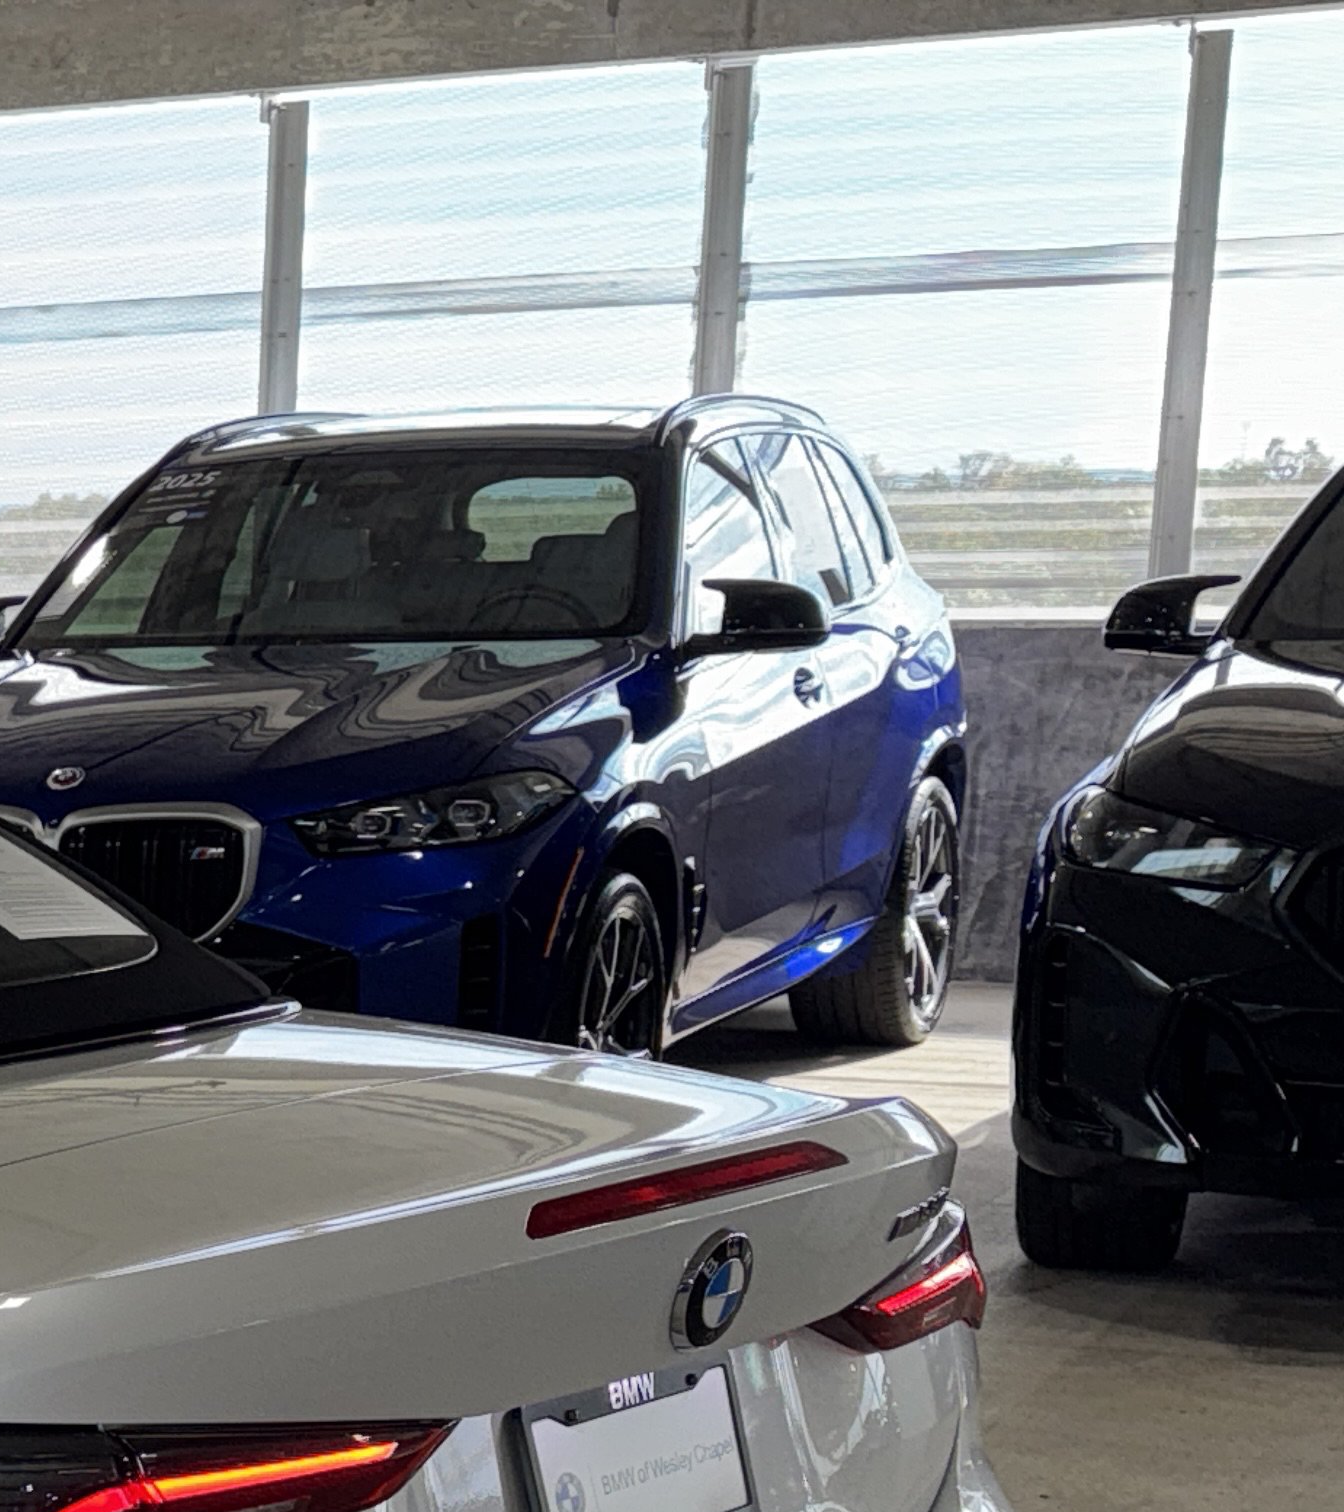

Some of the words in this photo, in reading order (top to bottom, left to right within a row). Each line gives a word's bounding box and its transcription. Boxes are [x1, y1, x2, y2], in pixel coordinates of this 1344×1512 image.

[148, 470, 222, 492] 2025
[608, 1372, 655, 1409] BMW
[602, 1465, 636, 1495] BMW
[638, 1461, 650, 1483] of
[650, 1452, 694, 1477] Wesley
[694, 1437, 734, 1464] Chapel
